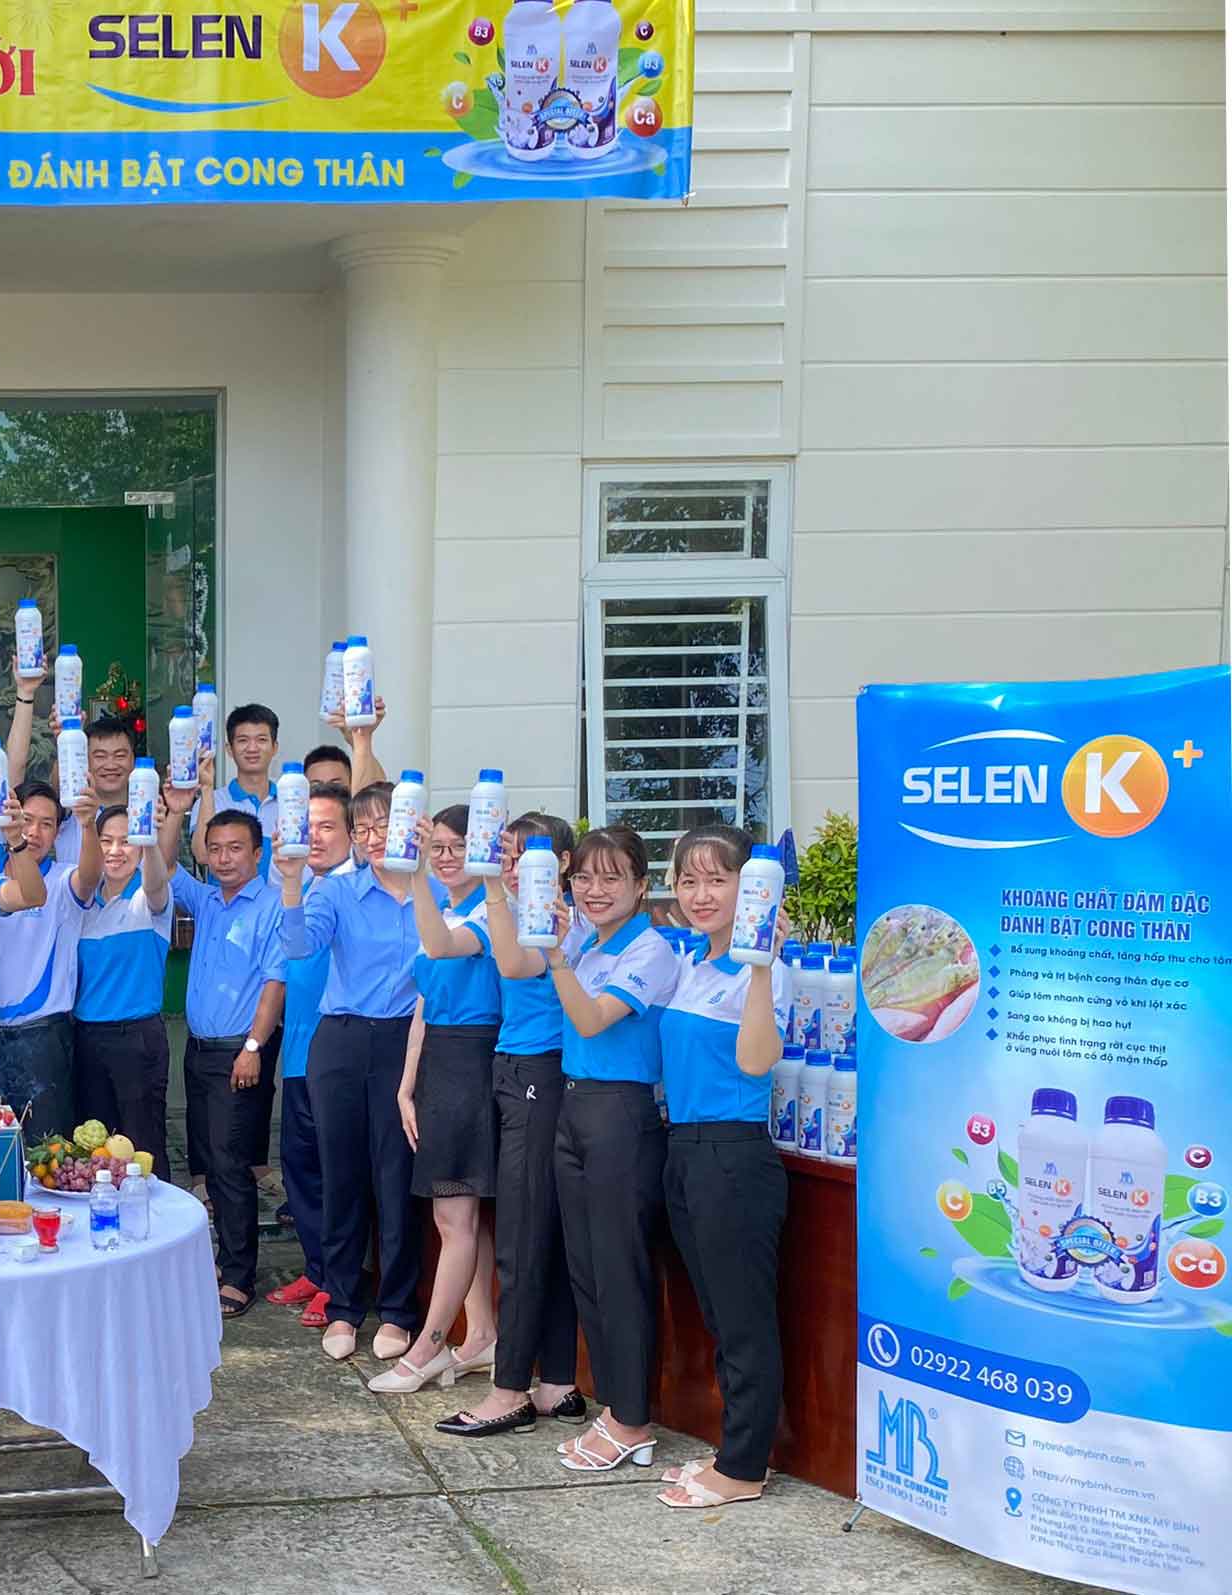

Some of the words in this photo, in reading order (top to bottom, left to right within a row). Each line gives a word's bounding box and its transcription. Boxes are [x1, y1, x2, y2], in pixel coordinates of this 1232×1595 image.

[88, 14, 262, 60] SELEN
[301, 2, 361, 73] K
[474, 26, 489, 38] B3
[633, 108, 656, 125] Ca
[8, 150, 109, 189] ĐÁNH
[121, 152, 186, 196] BẬT
[195, 157, 304, 187] CONG
[314, 152, 405, 188] THÂN
[902, 765, 1048, 804] SELEN
[1084, 751, 1143, 814] K
[1087, 919, 1135, 938] CONG
[971, 1121, 991, 1138] B3
[1189, 1150, 1206, 1163] C
[1024, 1176, 1052, 1190] SELEN
[945, 1192, 963, 1211] C
[1097, 1187, 1128, 1200] SELEN
[1196, 1190, 1221, 1208] B3
[1174, 1253, 1218, 1276] Ca
[911, 1346, 972, 1382] 02922
[976, 1366, 1019, 1394] 468
[1025, 1378, 1074, 1405] 039
